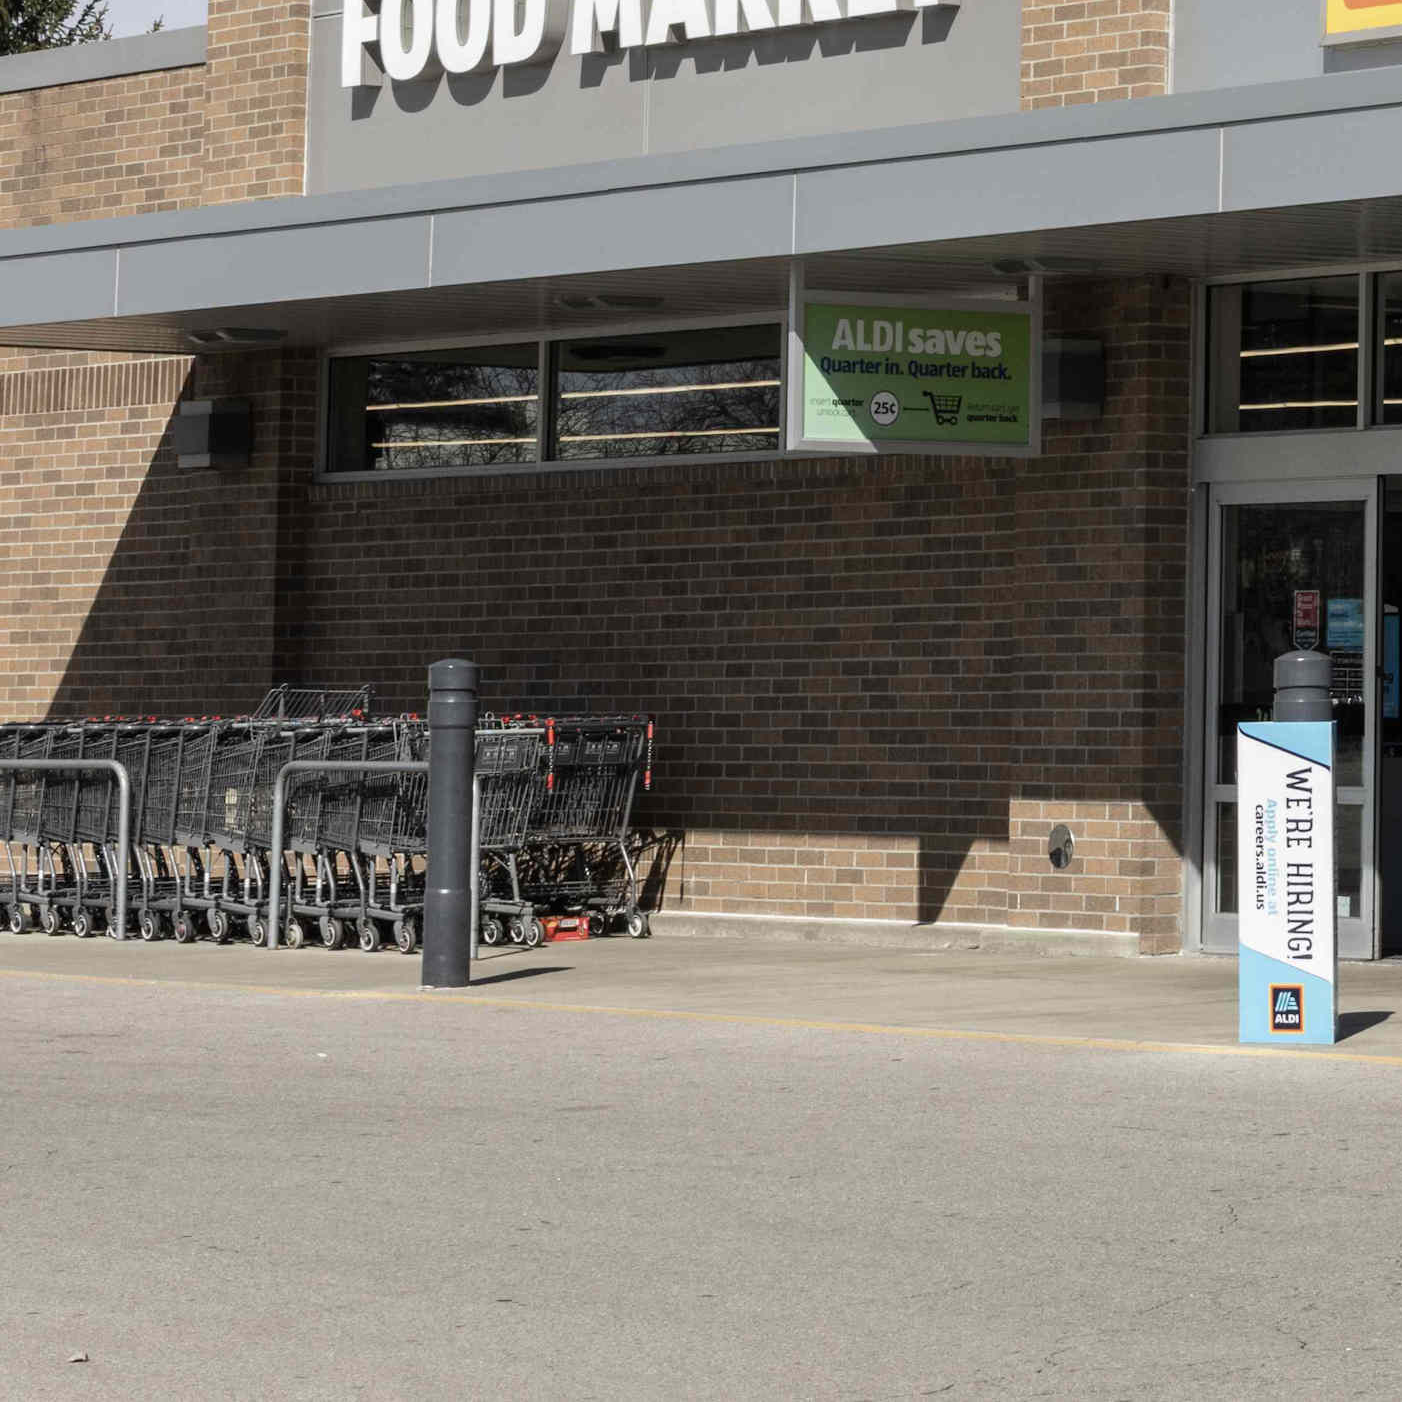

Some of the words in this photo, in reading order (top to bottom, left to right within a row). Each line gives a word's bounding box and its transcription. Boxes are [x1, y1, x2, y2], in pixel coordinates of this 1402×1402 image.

[831, 318, 903, 353] ALDI
[907, 326, 1002, 358] saves
[820, 356, 881, 377] Quarter
[884, 358, 905, 375] in.
[908, 360, 968, 379] Quarter
[971, 361, 1013, 381] back.
[873, 401, 897, 416] 25¢
[1286, 767, 1313, 849] WE'RE
[1256, 804, 1267, 910] careers.aldi.us
[1286, 863, 1314, 960] HIRING!
[1274, 1013, 1300, 1025] ALDI
